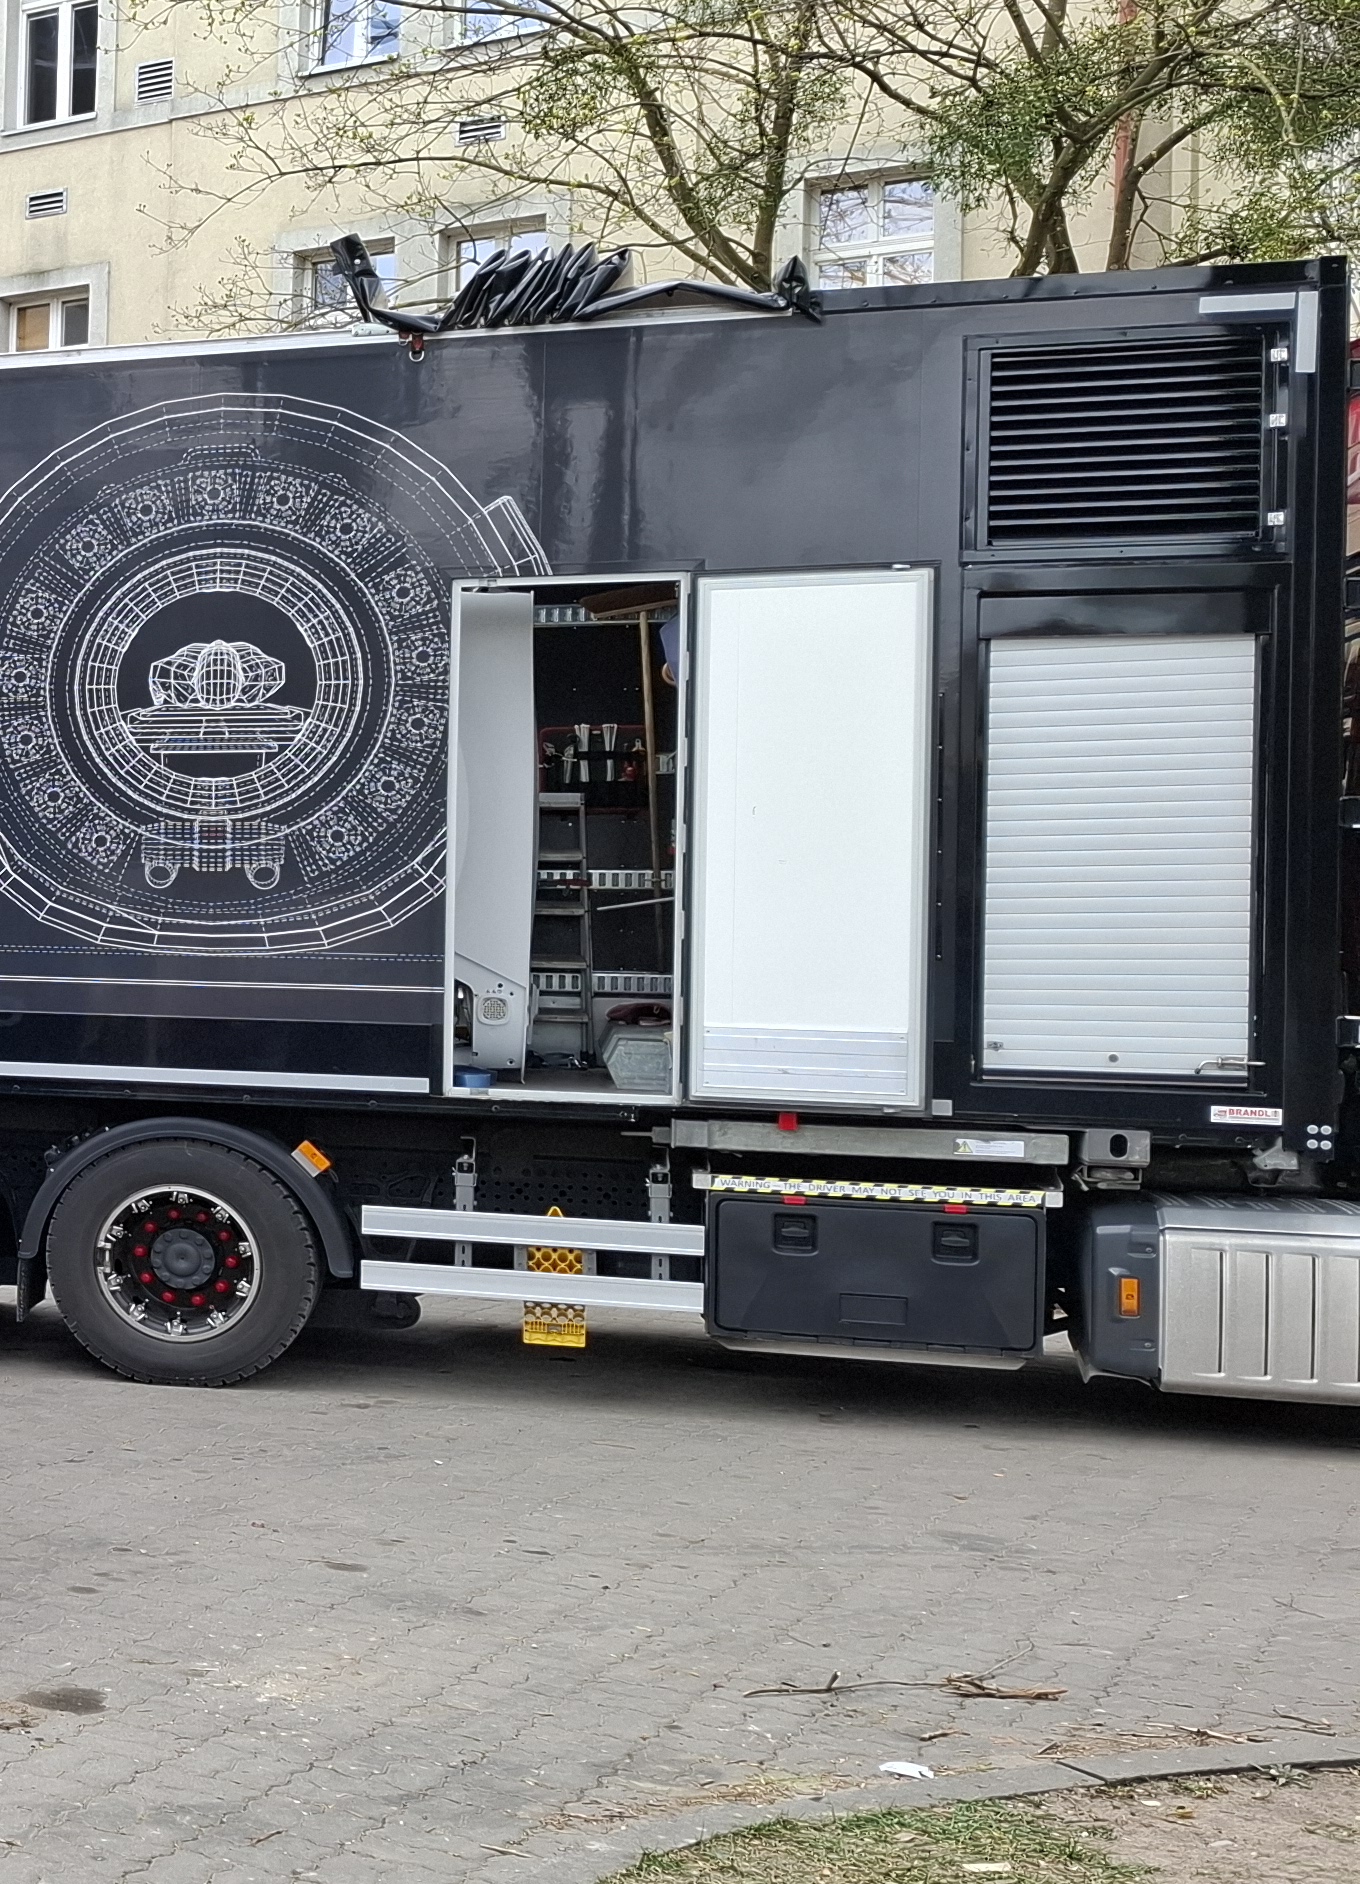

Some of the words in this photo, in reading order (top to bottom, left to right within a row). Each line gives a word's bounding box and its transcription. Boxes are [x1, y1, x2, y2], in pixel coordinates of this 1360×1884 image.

[1228, 1108, 1271, 1118] BRANDL
[720, 1179, 771, 1189] WARNING
[783, 1182, 803, 1191] THE
[808, 1183, 846, 1193] DRIVER
[851, 1186, 875, 1194] MAY
[880, 1187, 902, 1197] NOT
[908, 1189, 927, 1198] SEE
[932, 1190, 956, 1199] YOU
[961, 1191, 973, 1199] IN
[980, 1192, 1003, 1202] THIS
[1007, 1194, 1036, 1203] AREA
